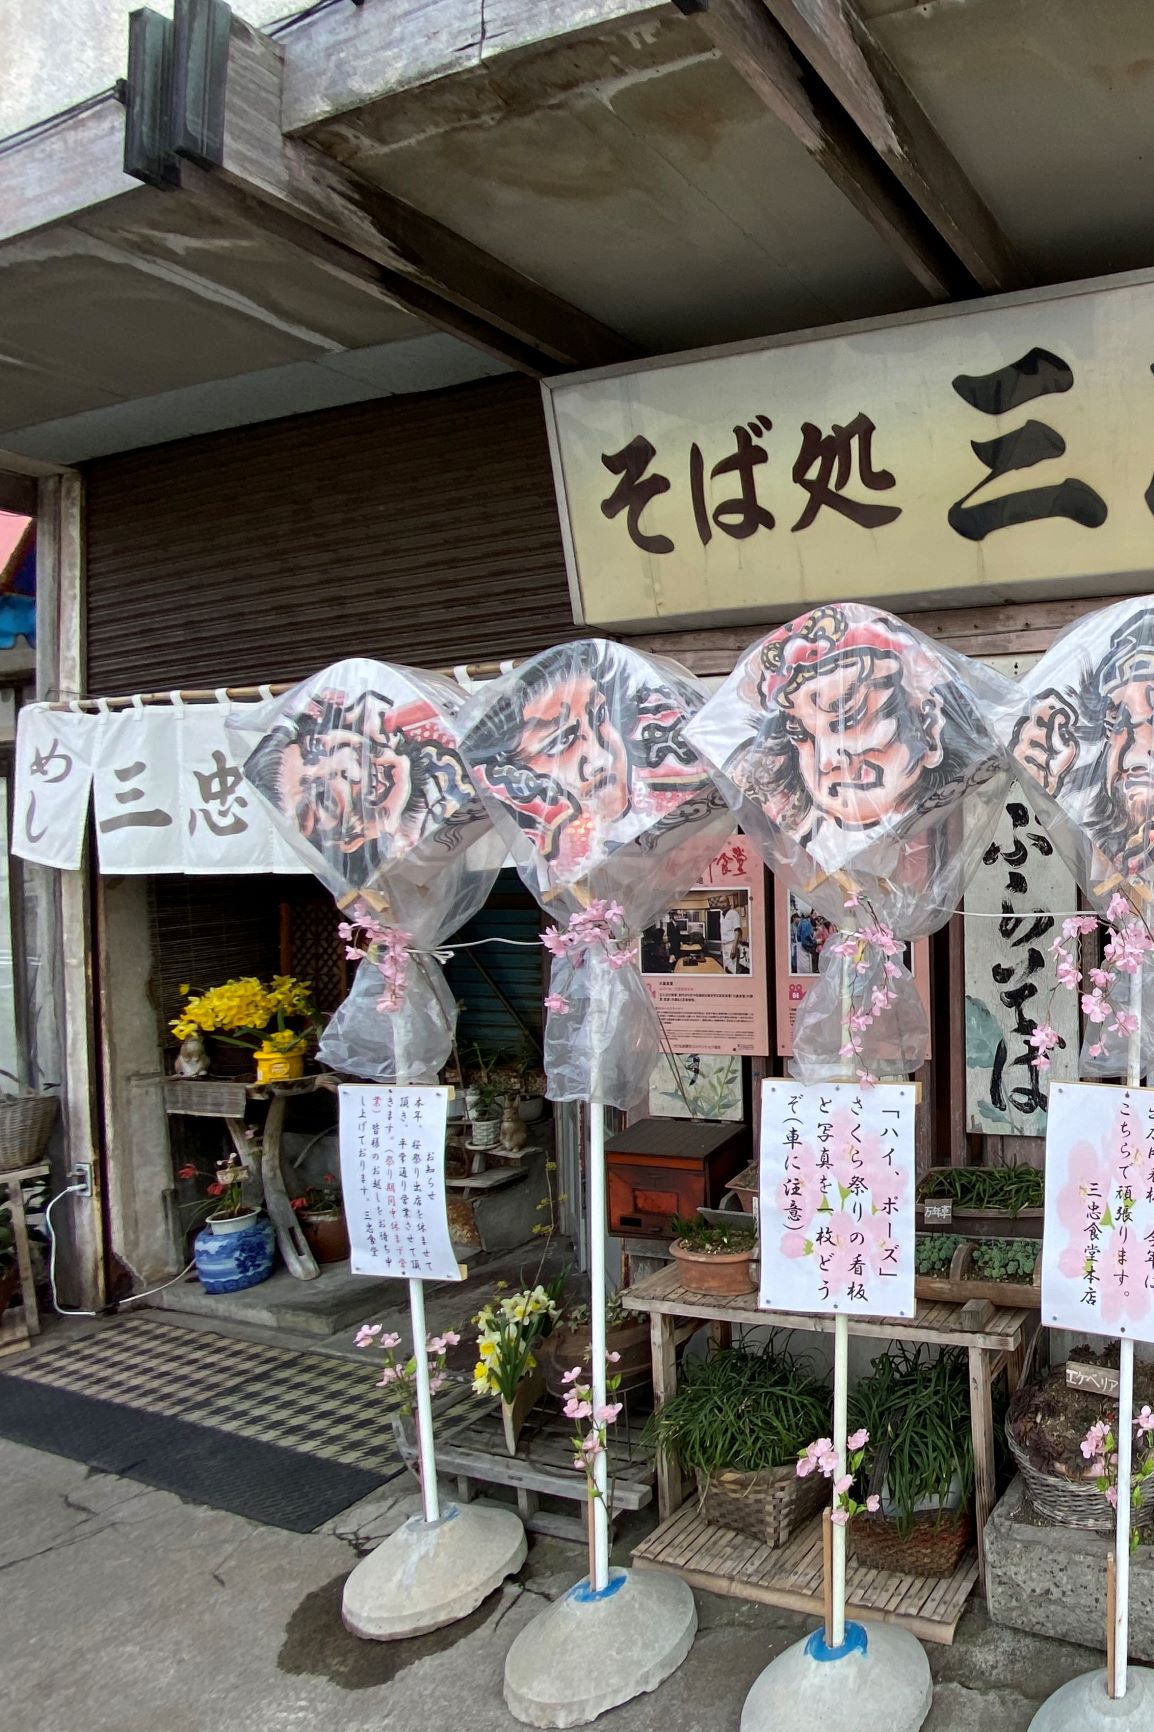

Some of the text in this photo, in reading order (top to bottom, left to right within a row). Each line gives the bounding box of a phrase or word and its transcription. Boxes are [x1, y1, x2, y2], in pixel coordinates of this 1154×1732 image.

[600, 413, 903, 555] そば処
[25, 738, 72, 843] めし
[99, 749, 249, 837] 三忠
[709, 846, 748, 884] 食堂
[425, 1152, 437, 1201] お知らせ
[815, 1096, 837, 1301] と写真を一枚どう
[847, 1096, 869, 1302] さくら祭りの看板
[1113, 1101, 1135, 1298] こちらで頑張ります。
[1079, 1182, 1103, 1306] 三忠食堂本店
[1066, 1368, 1119, 1393] エケベリア
